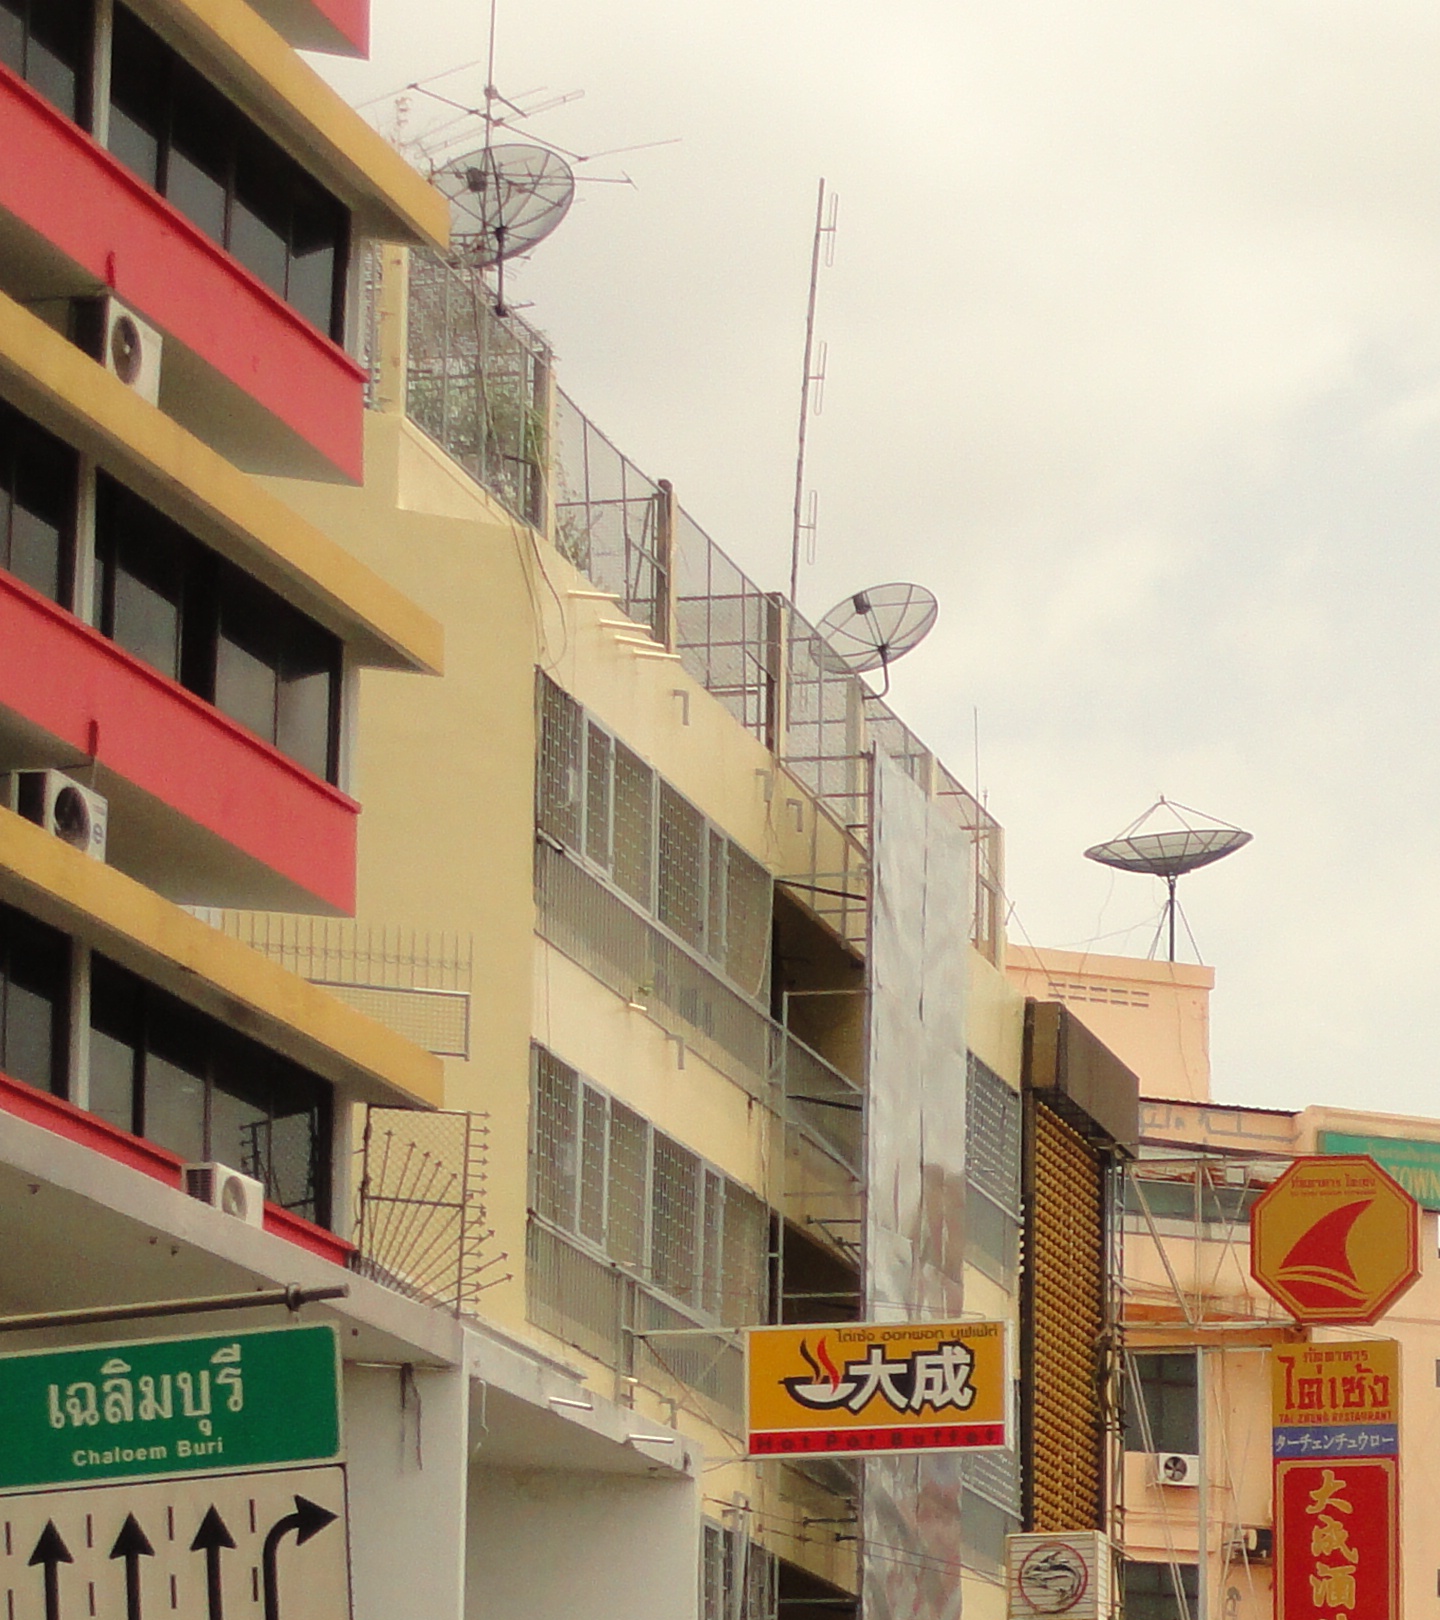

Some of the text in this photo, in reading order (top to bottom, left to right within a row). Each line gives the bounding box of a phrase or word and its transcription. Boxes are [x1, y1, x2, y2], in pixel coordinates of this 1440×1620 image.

[48, 1342, 244, 1437] เฉลิมบุรี
[848, 1345, 976, 1412] 大成
[72, 1436, 224, 1469] Chaloem Buri
[757, 1435, 809, 1450] Hot
[826, 1432, 876, 1448] Pot
